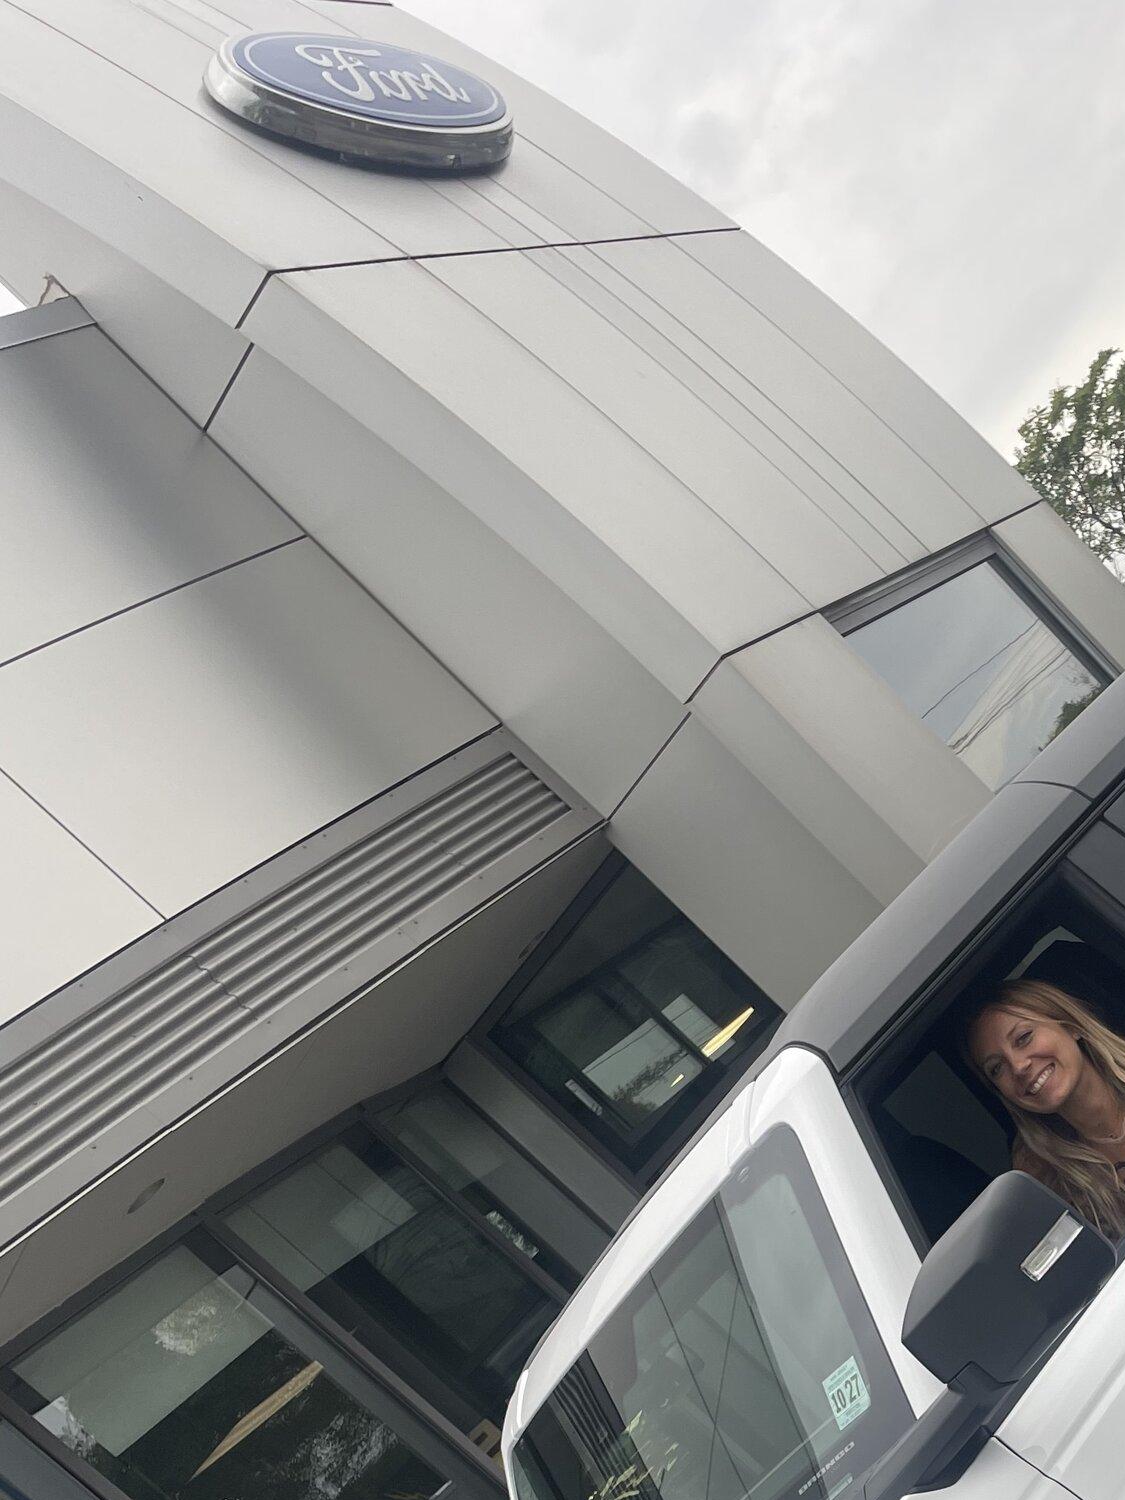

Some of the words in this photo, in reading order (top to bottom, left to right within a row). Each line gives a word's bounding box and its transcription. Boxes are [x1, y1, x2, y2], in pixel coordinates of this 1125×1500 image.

[295, 44, 470, 104] Ford
[831, 1388, 847, 1414] 10
[844, 1373, 861, 1404] 27
[798, 1441, 855, 1495] BRONCO
